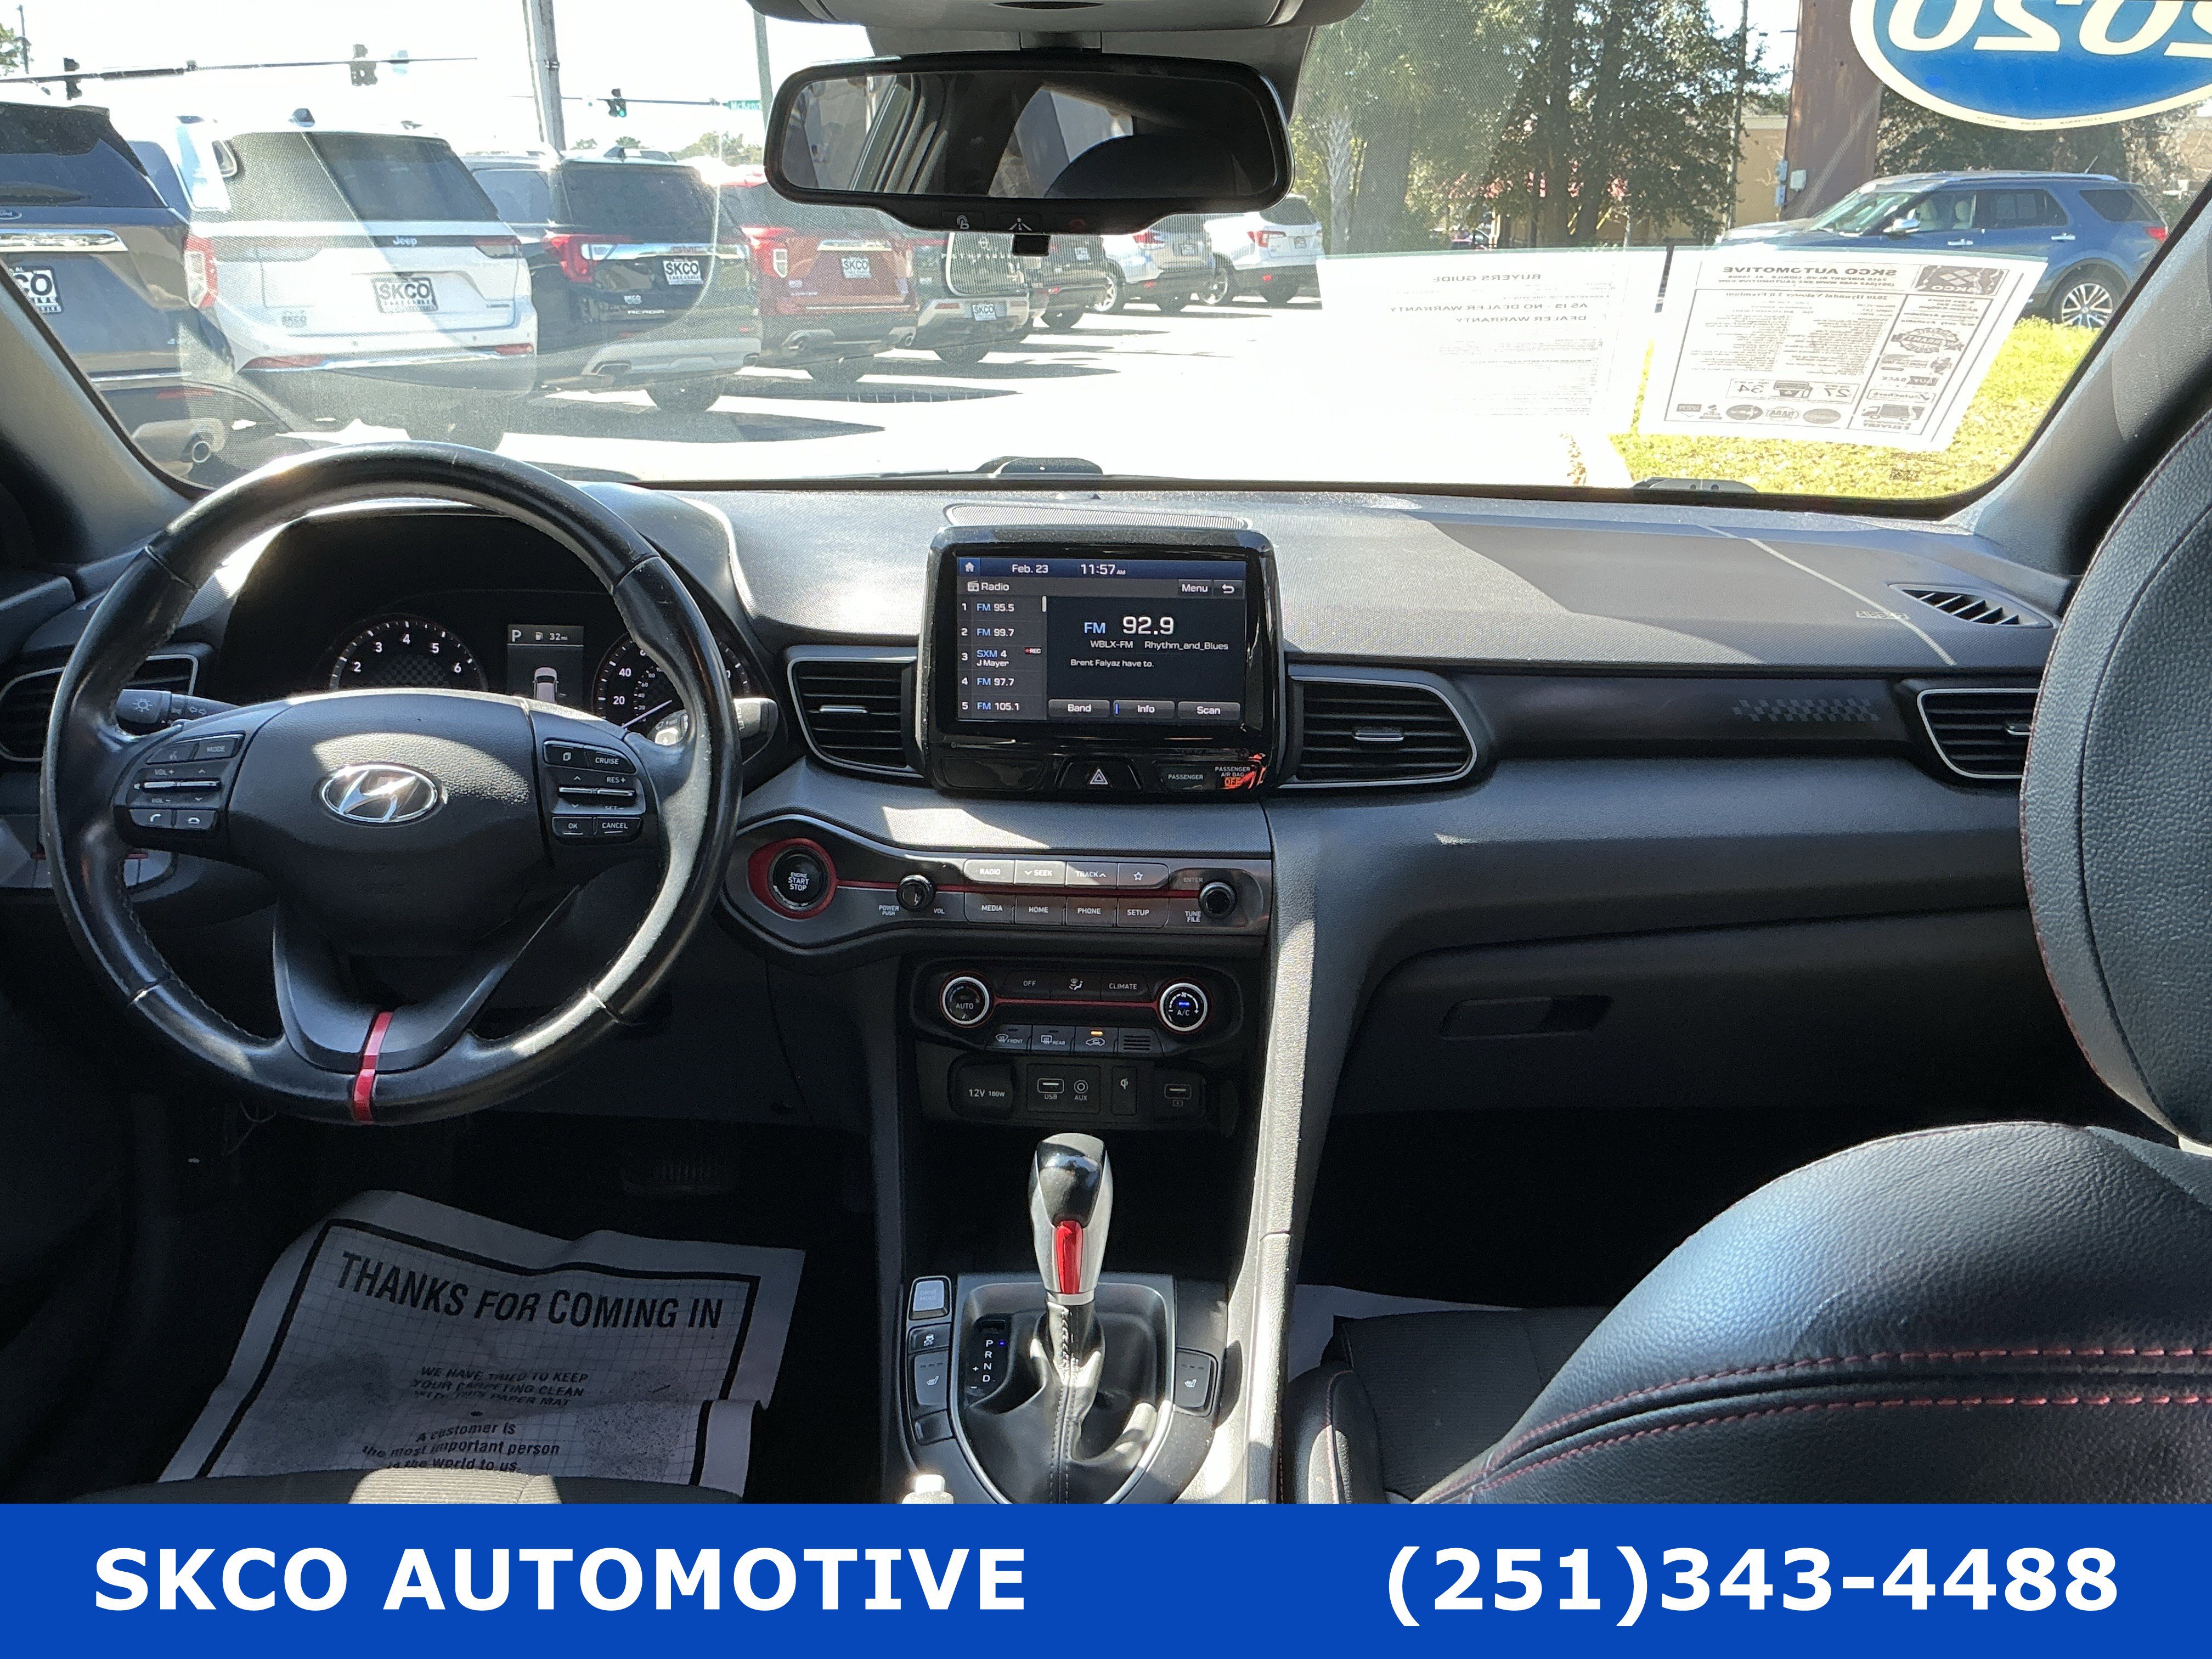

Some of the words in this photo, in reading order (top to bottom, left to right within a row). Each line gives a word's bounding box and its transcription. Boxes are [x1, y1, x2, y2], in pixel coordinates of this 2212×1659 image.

[393, 236, 417, 247] Jeep
[665, 262, 699, 275] SKCO
[843, 260, 868, 270] SKCO
[379, 282, 431, 299] SKCO
[1012, 564, 1033, 573] Feb.
[1034, 564, 1048, 573] 23
[1081, 564, 1115, 575] 11:57
[981, 582, 1009, 592] Radio
[1182, 584, 1208, 593] Menu
[962, 603, 967, 611] 1
[977, 603, 991, 612] FM
[994, 603, 1014, 612] 95.5
[1084, 622, 1106, 634] FM
[1122, 617, 1174, 635] 92.9
[512, 629, 522, 642] P
[961, 628, 968, 636] 2
[977, 628, 991, 637] FM
[994, 628, 1014, 637] 99.7
[402, 634, 410, 645] 4
[375, 641, 382, 653] 3
[432, 642, 439, 653] 5
[1091, 640, 1133, 649] WBLX-FM
[1144, 640, 1229, 652] Rhythm_and_Blues
[977, 650, 998, 658] SXM
[1000, 650, 1007, 658] 4
[354, 662, 361, 672] 2
[454, 662, 461, 673] 6
[1070, 659, 1094, 668] Brent
[1122, 659, 1141, 668] have
[1142, 660, 1155, 668] to.
[619, 668, 631, 677] 40
[962, 678, 968, 686] 4
[977, 678, 991, 686] FM
[994, 678, 1014, 687] 97.7
[613, 696, 625, 705] 20
[962, 702, 968, 710] 5
[977, 702, 991, 711] FM
[995, 703, 1019, 712] 105.1
[1067, 704, 1091, 713] Band
[1137, 705, 1155, 714] Info
[1197, 706, 1221, 715] Scan
[969, 1088, 985, 1097] 12V
[337, 1251, 467, 1317] THANKS
[474, 1290, 541, 1323] FOR
[549, 1289, 679, 1328] COMING
[687, 1297, 723, 1328] IN
[421, 1366, 443, 1377] WE
[445, 1368, 483, 1380] HAVE
[532, 1372, 549, 1381] TO
[553, 1372, 589, 1383] KEEP
[409, 1379, 452, 1391] YOUR
[538, 1386, 584, 1397] CLEAN
[490, 1392, 537, 1404] PAPER
[539, 1397, 572, 1407] MAT
[416, 1434, 427, 1443] A
[430, 1424, 499, 1440] customer
[362, 1445, 386, 1458] the
[390, 1445, 426, 1458] most
[430, 1441, 504, 1454] important
[507, 1443, 560, 1455] person
[480, 1458, 494, 1471] to
